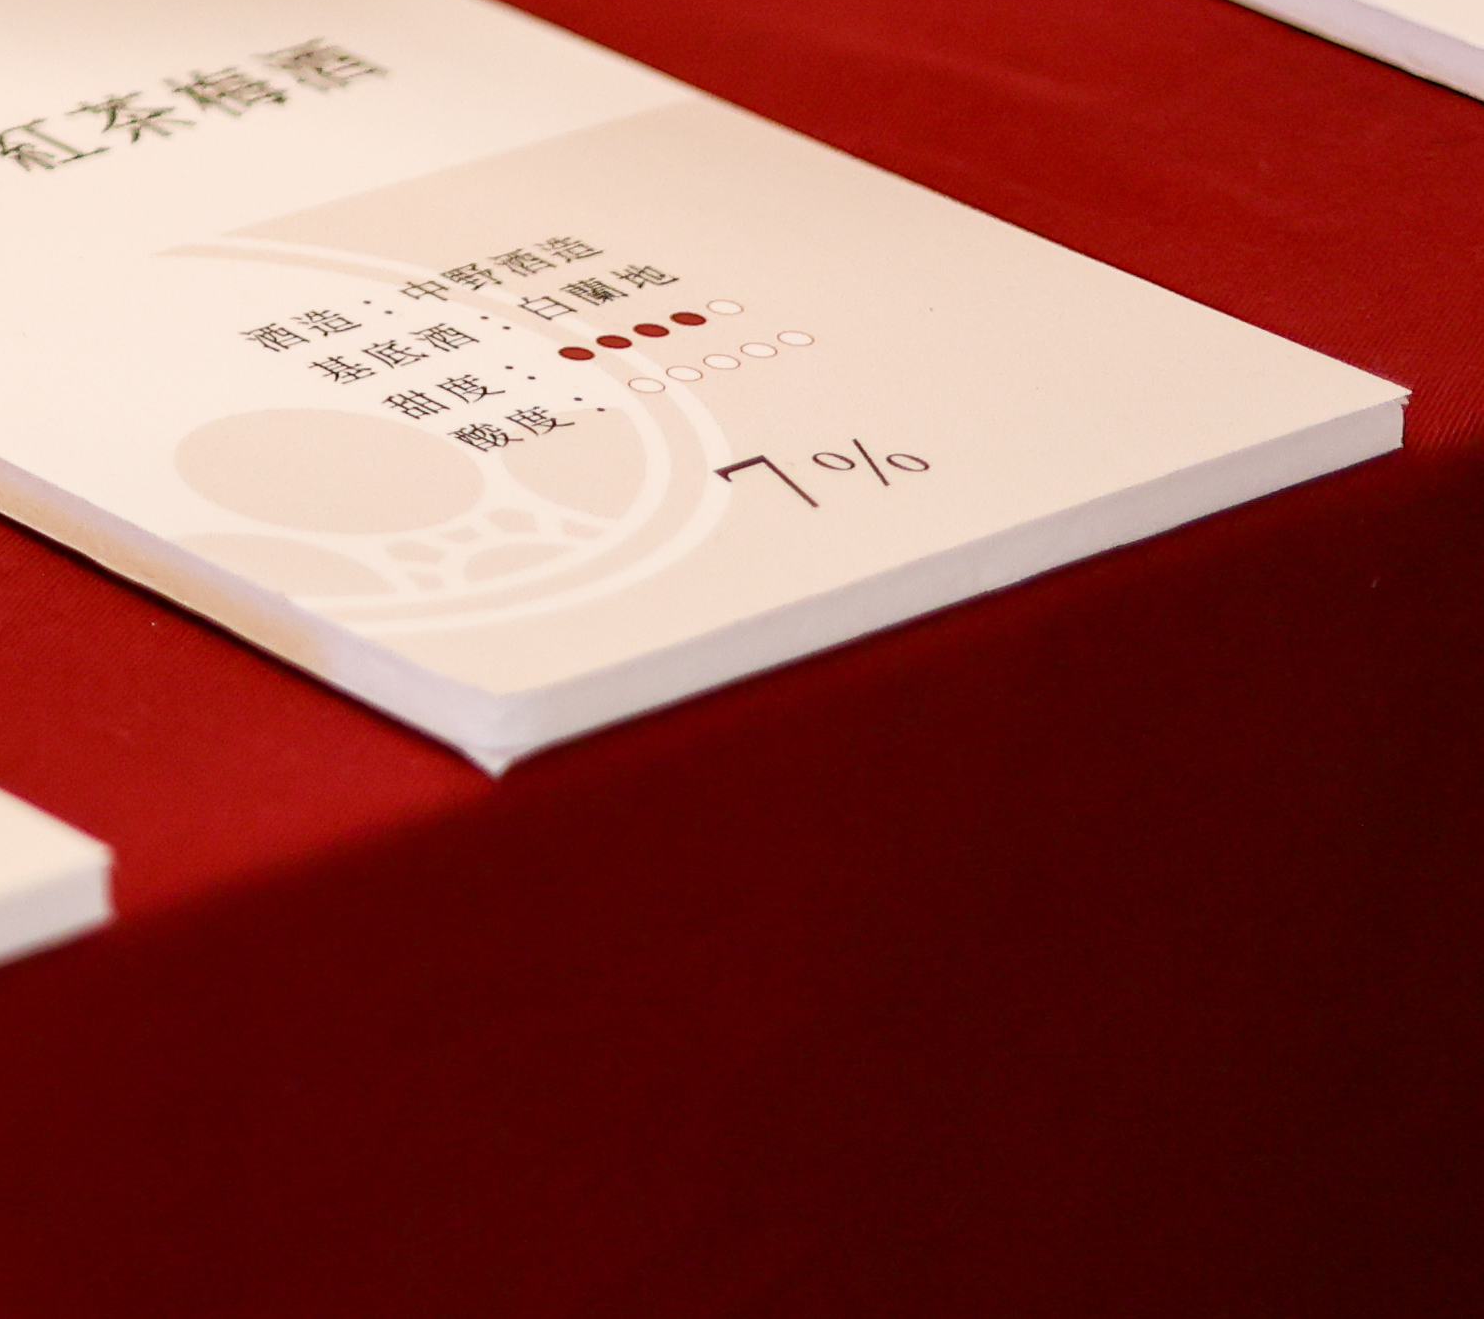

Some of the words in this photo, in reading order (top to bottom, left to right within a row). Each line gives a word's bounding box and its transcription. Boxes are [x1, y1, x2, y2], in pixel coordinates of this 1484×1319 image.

[239, 233, 605, 354] 酒造：中野酒造
[307, 261, 680, 387] 基底酒：白蘭地
[383, 362, 537, 422] 甜度：
[446, 394, 607, 454] 酸度：
[712, 437, 933, 510] 7%
